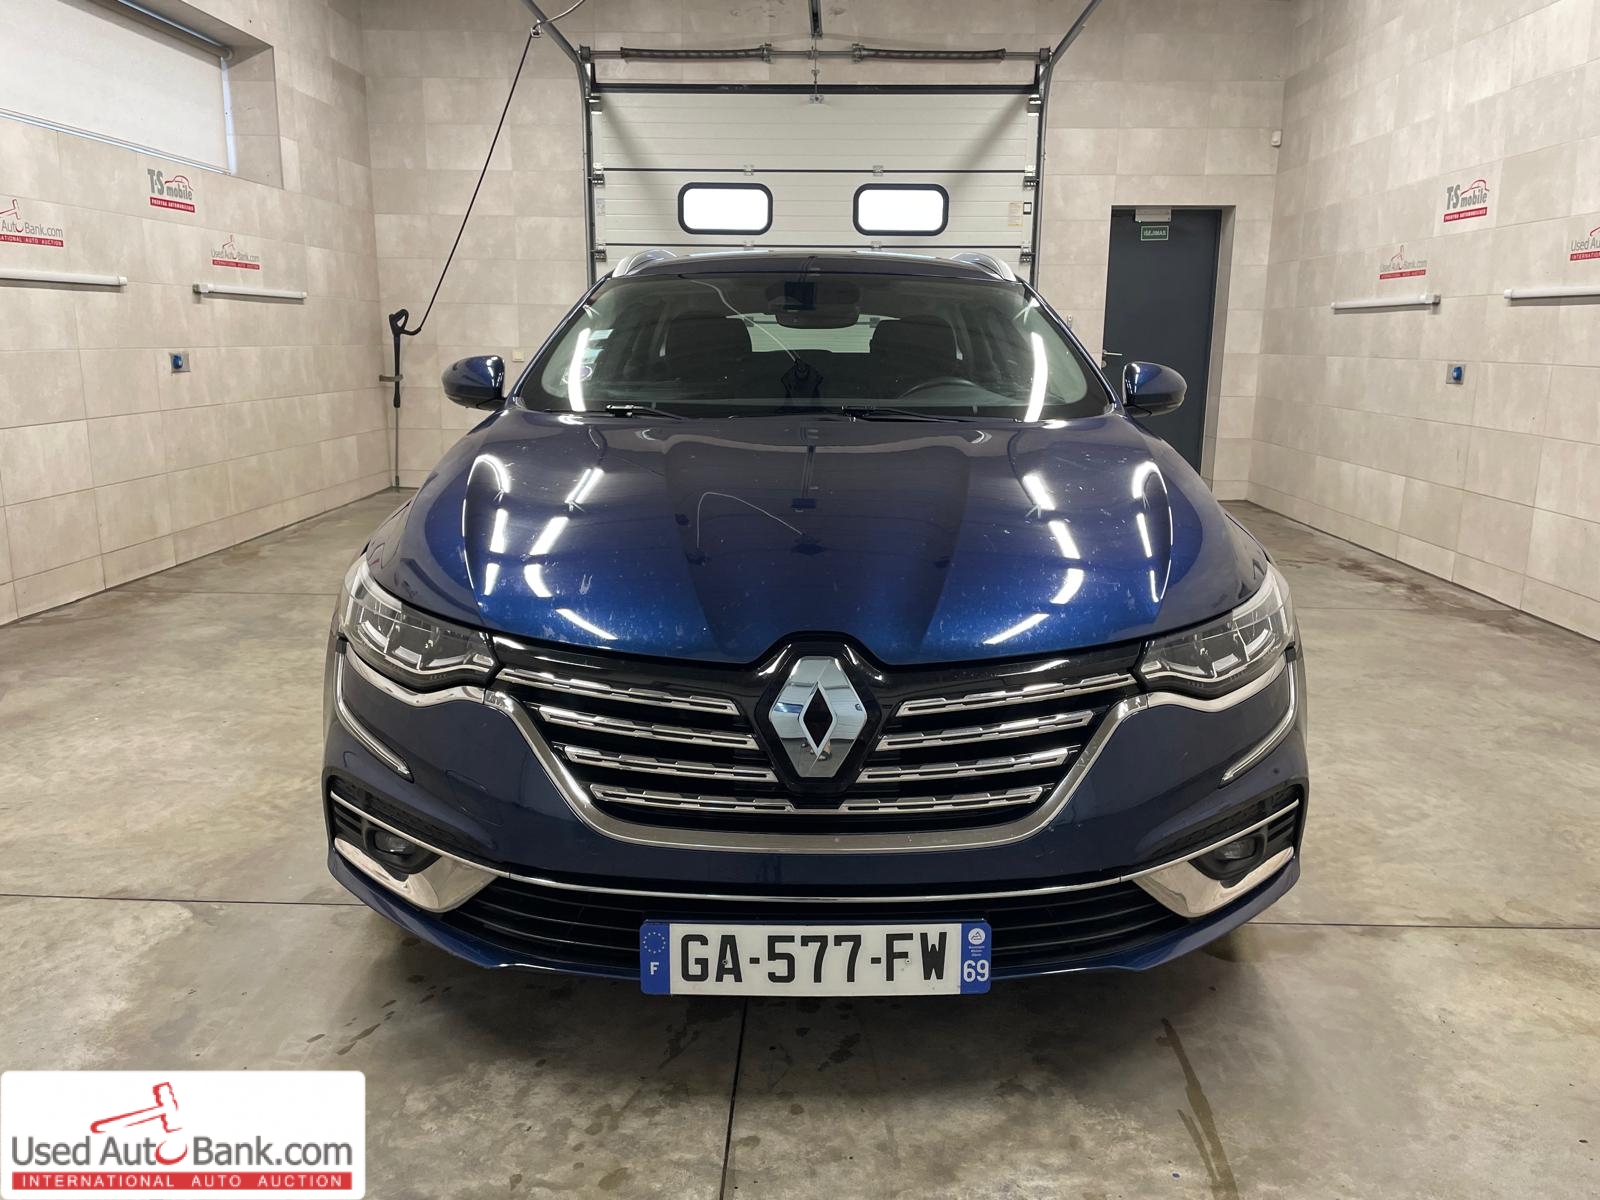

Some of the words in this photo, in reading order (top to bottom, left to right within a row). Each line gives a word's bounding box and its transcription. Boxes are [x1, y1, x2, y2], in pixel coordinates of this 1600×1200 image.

[166, 183, 193, 201] mobile
[1460, 188, 1488, 208] mobile
[1571, 237, 1590, 251] Used
[681, 932, 947, 983] GA-577-FW
[650, 961, 660, 975] F
[963, 959, 990, 982] 69
